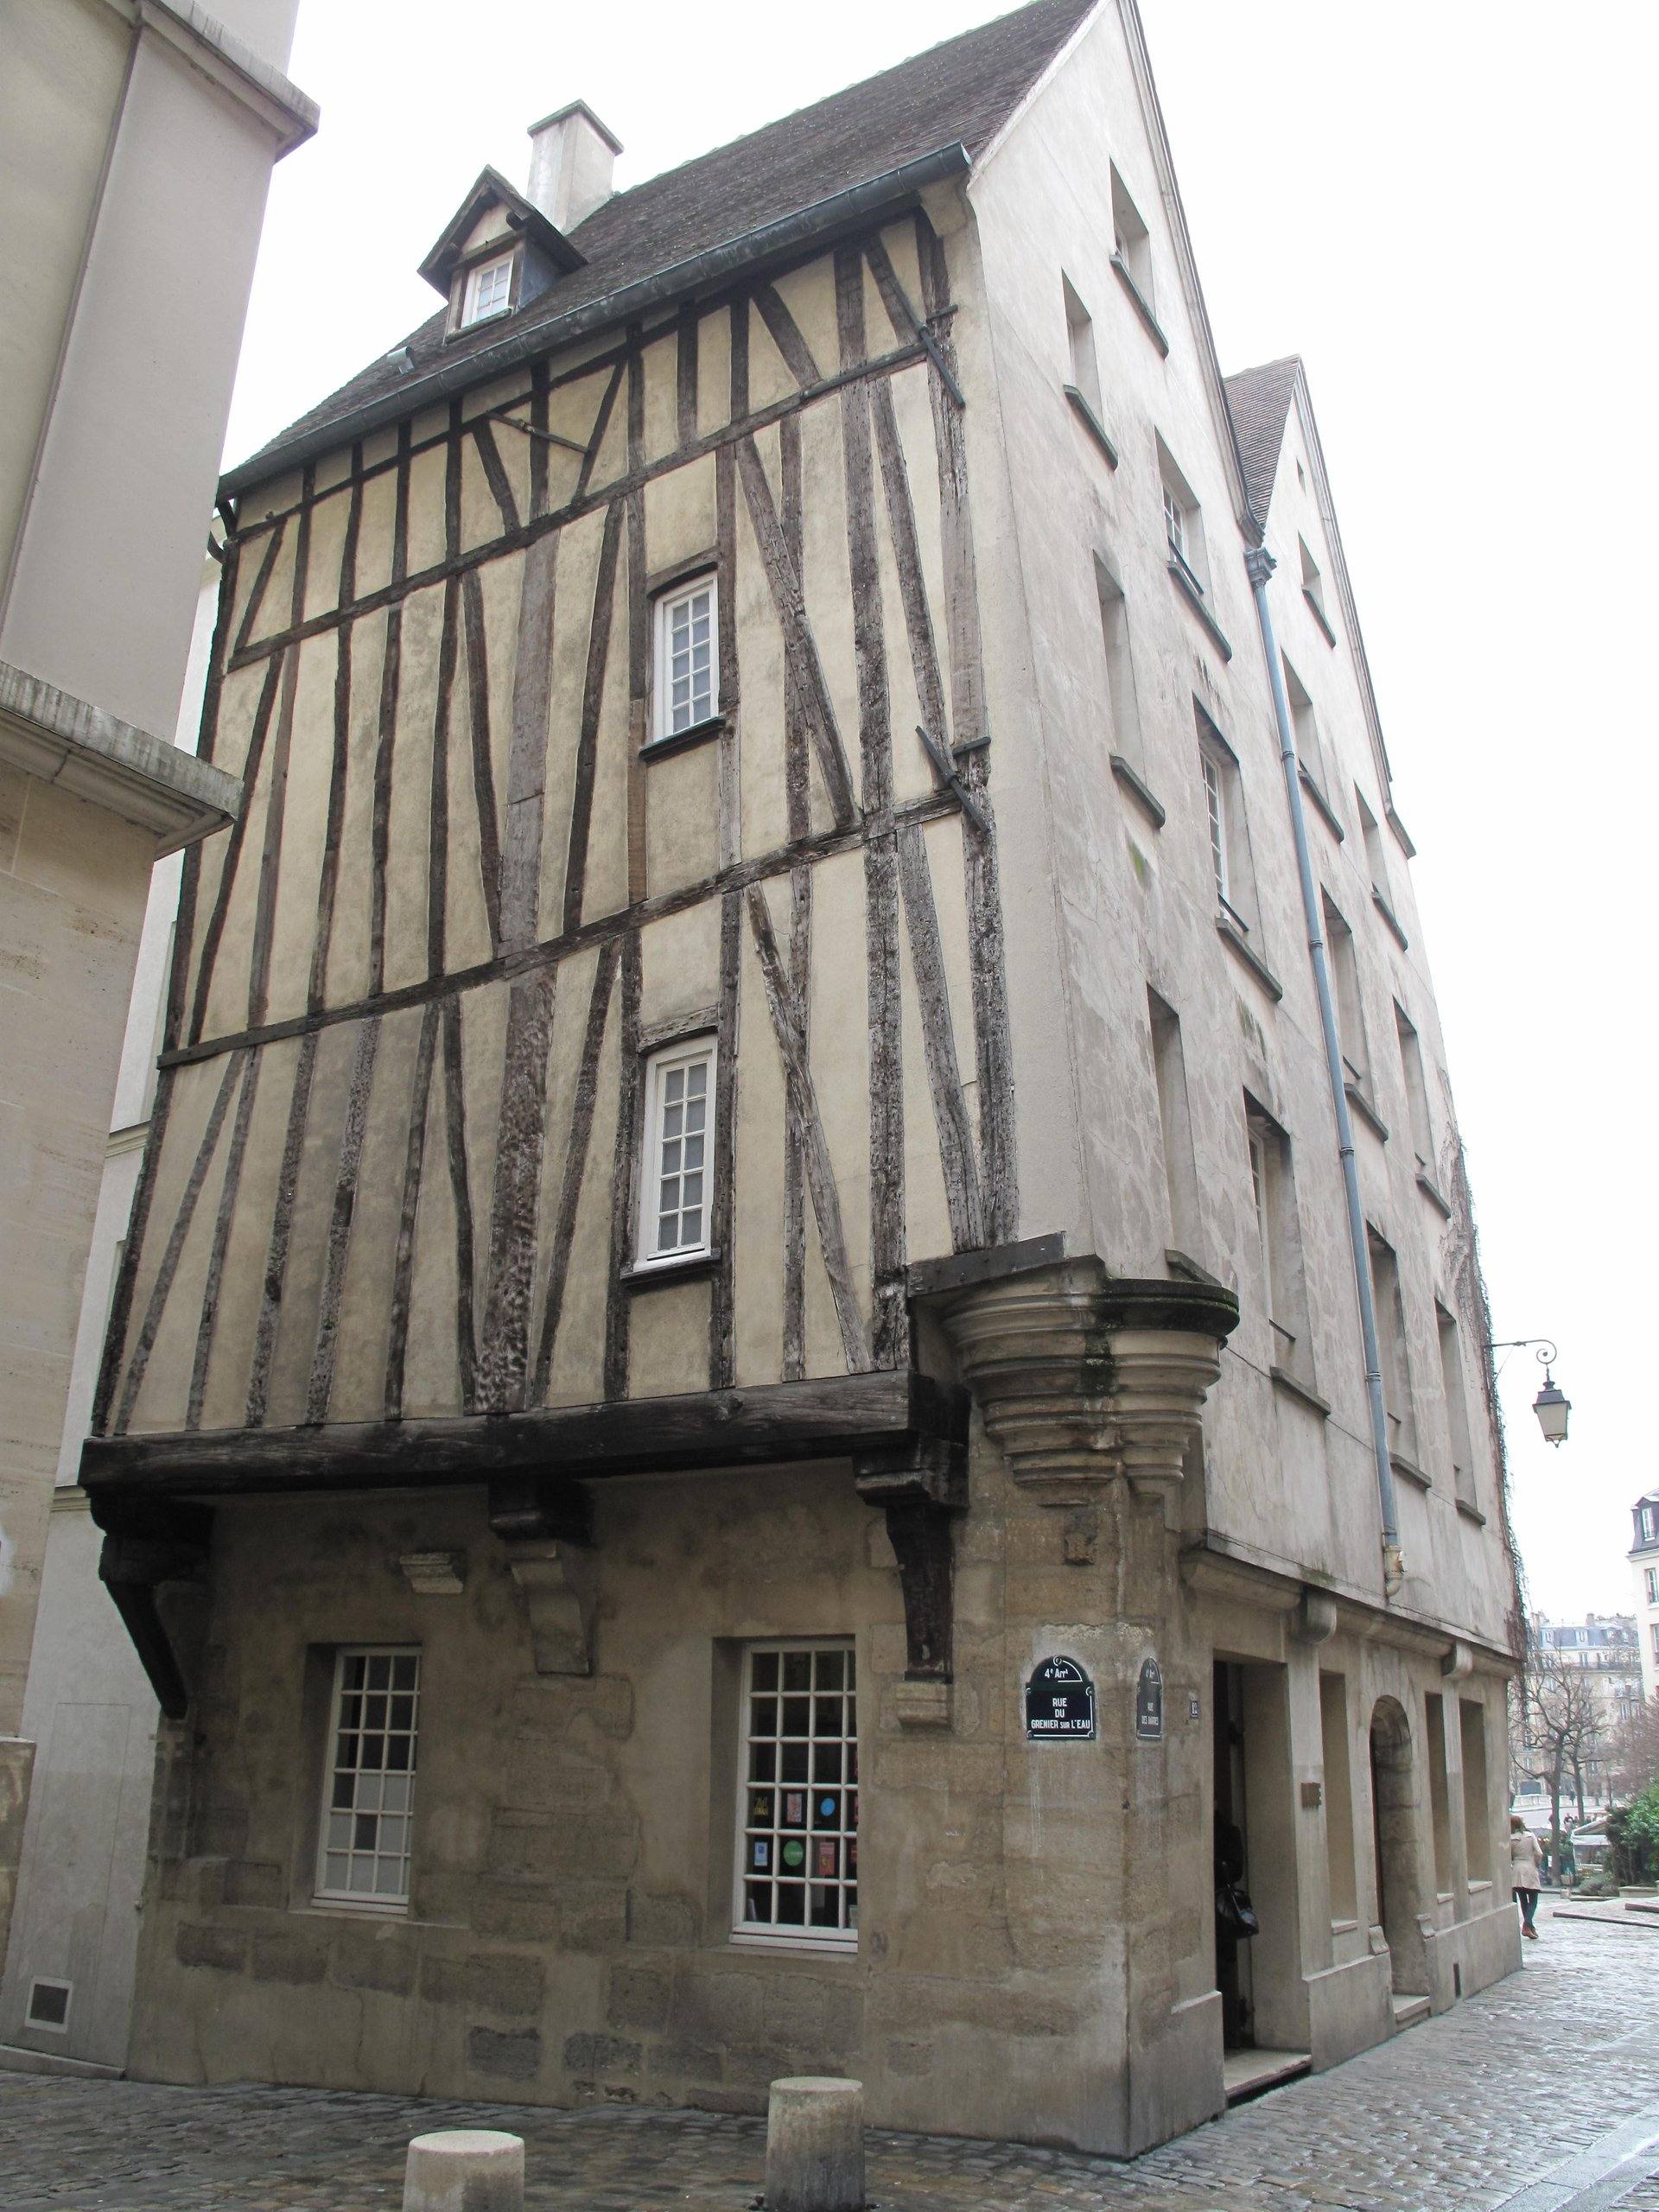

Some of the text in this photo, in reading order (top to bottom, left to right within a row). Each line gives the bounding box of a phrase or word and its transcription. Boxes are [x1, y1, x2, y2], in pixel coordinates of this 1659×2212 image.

[1052, 1697, 1067, 1707] RUE
[1054, 1709, 1065, 1718] DU
[1031, 1719, 1058, 1729] GRENIER
[1071, 1719, 1090, 1729] L'EAU
